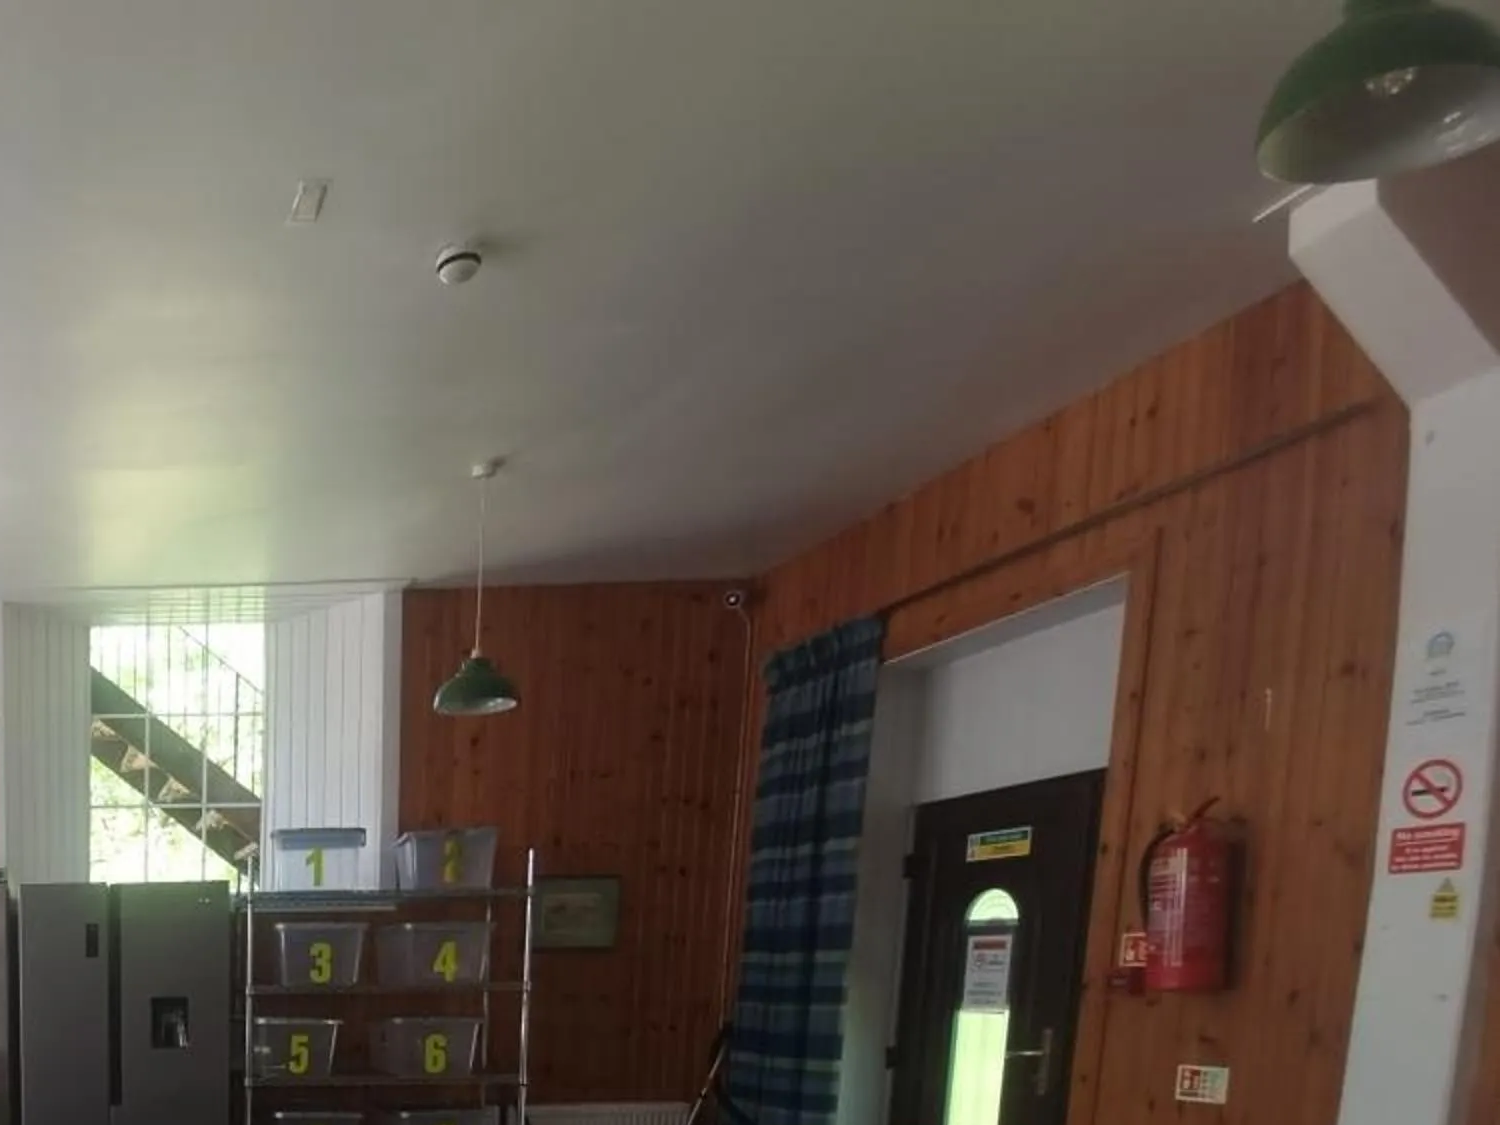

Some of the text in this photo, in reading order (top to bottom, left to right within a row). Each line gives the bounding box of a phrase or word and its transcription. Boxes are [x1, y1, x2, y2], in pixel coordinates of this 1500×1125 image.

[306, 846, 324, 887] 1
[443, 840, 463, 883] 2
[310, 942, 332, 984] 3
[433, 941, 457, 982] 4
[288, 1034, 309, 1074] 5
[424, 1033, 448, 1074] 6
